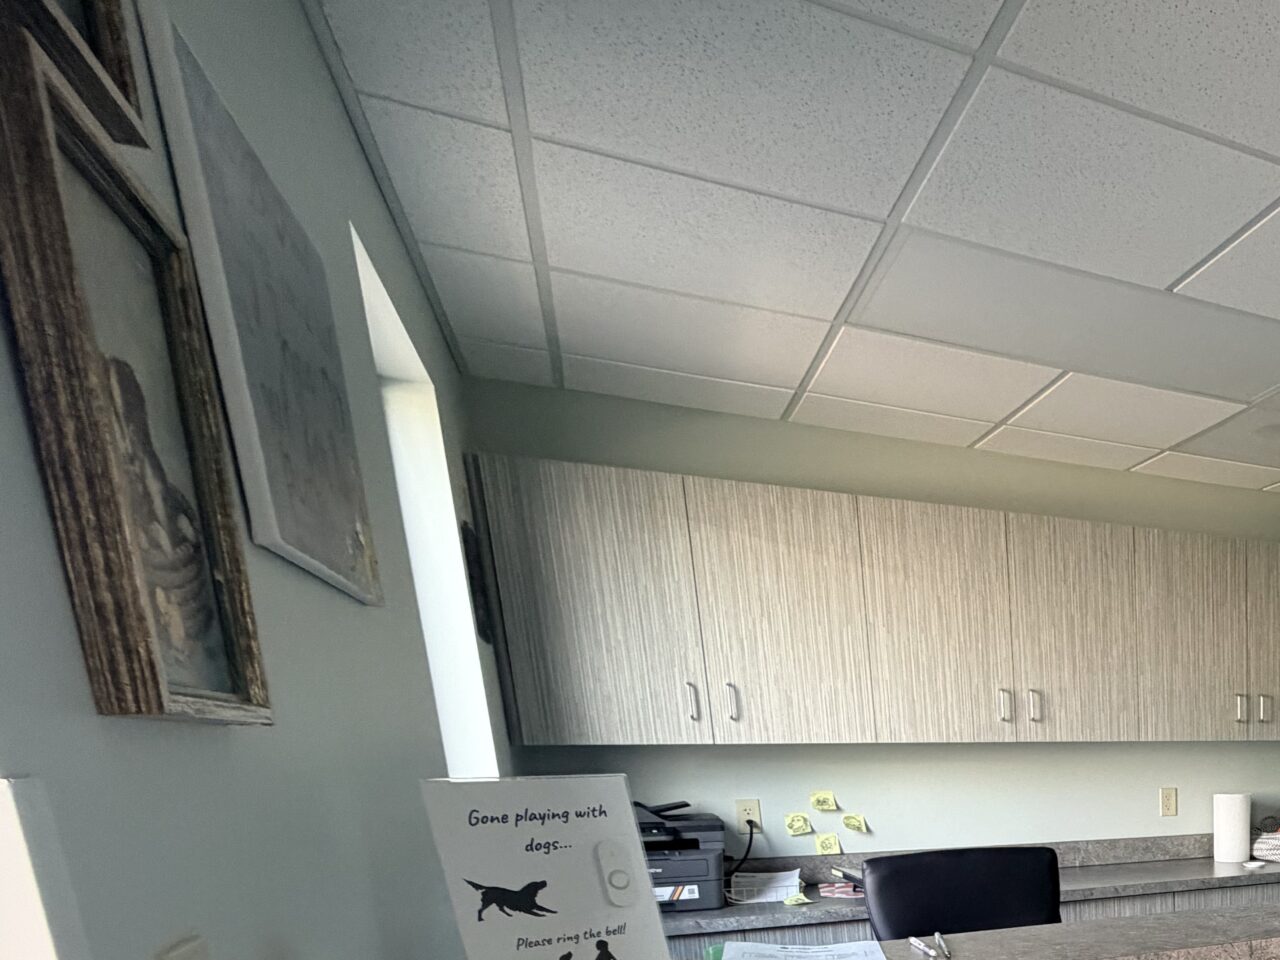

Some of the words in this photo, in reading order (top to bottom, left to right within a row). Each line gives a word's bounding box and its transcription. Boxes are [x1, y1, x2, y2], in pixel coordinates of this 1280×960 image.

[468, 809, 509, 826] Gone
[515, 808, 569, 827] playing
[575, 804, 608, 819] with
[525, 837, 572, 855] dogs...
[516, 937, 553, 951] Please
[557, 933, 580, 945] ring
[584, 928, 602, 940] the
[605, 923, 627, 937] bell!
